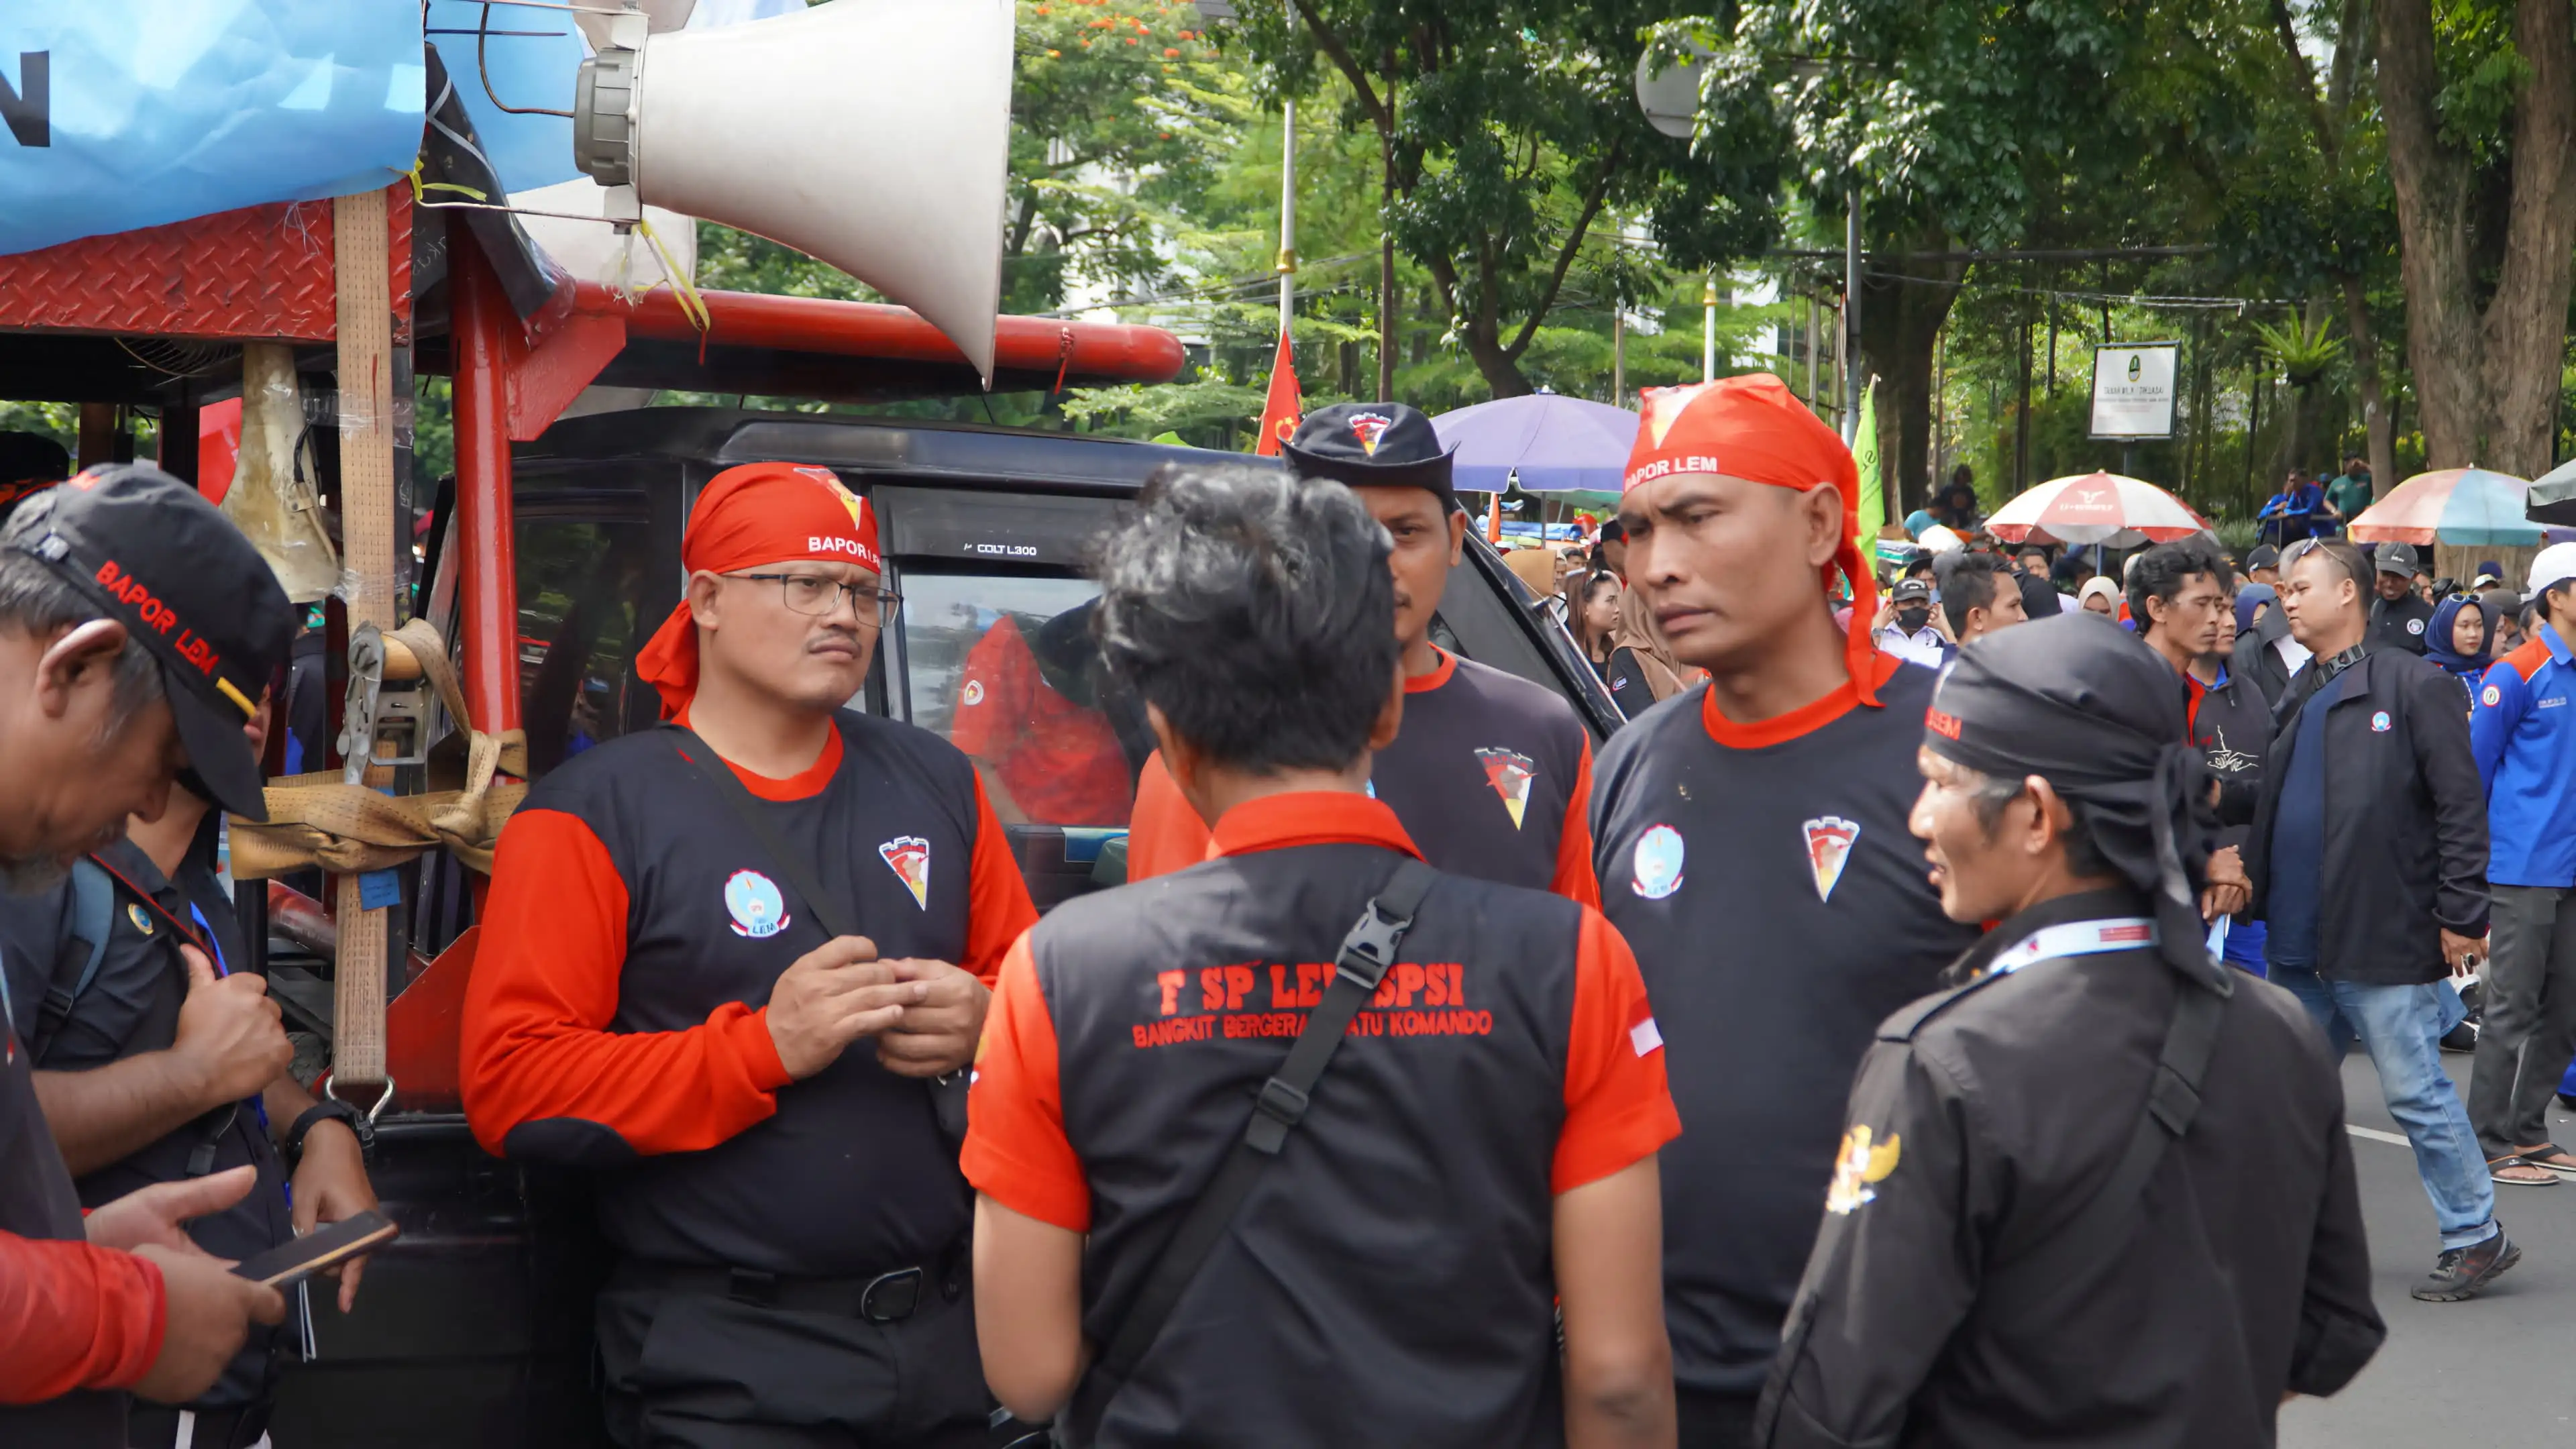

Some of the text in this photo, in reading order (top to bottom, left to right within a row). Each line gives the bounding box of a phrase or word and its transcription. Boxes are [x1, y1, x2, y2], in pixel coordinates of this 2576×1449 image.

[1674, 456, 1717, 472] LEM
[808, 536, 867, 559] BAPOR
[977, 544, 1037, 556] COLT L300
[95, 559, 219, 676] BAPOR LEM
[1200, 963, 1255, 1011] SP
[1132, 1010, 1492, 1049] BANGKIT BERGERA ATU KOMANDO
